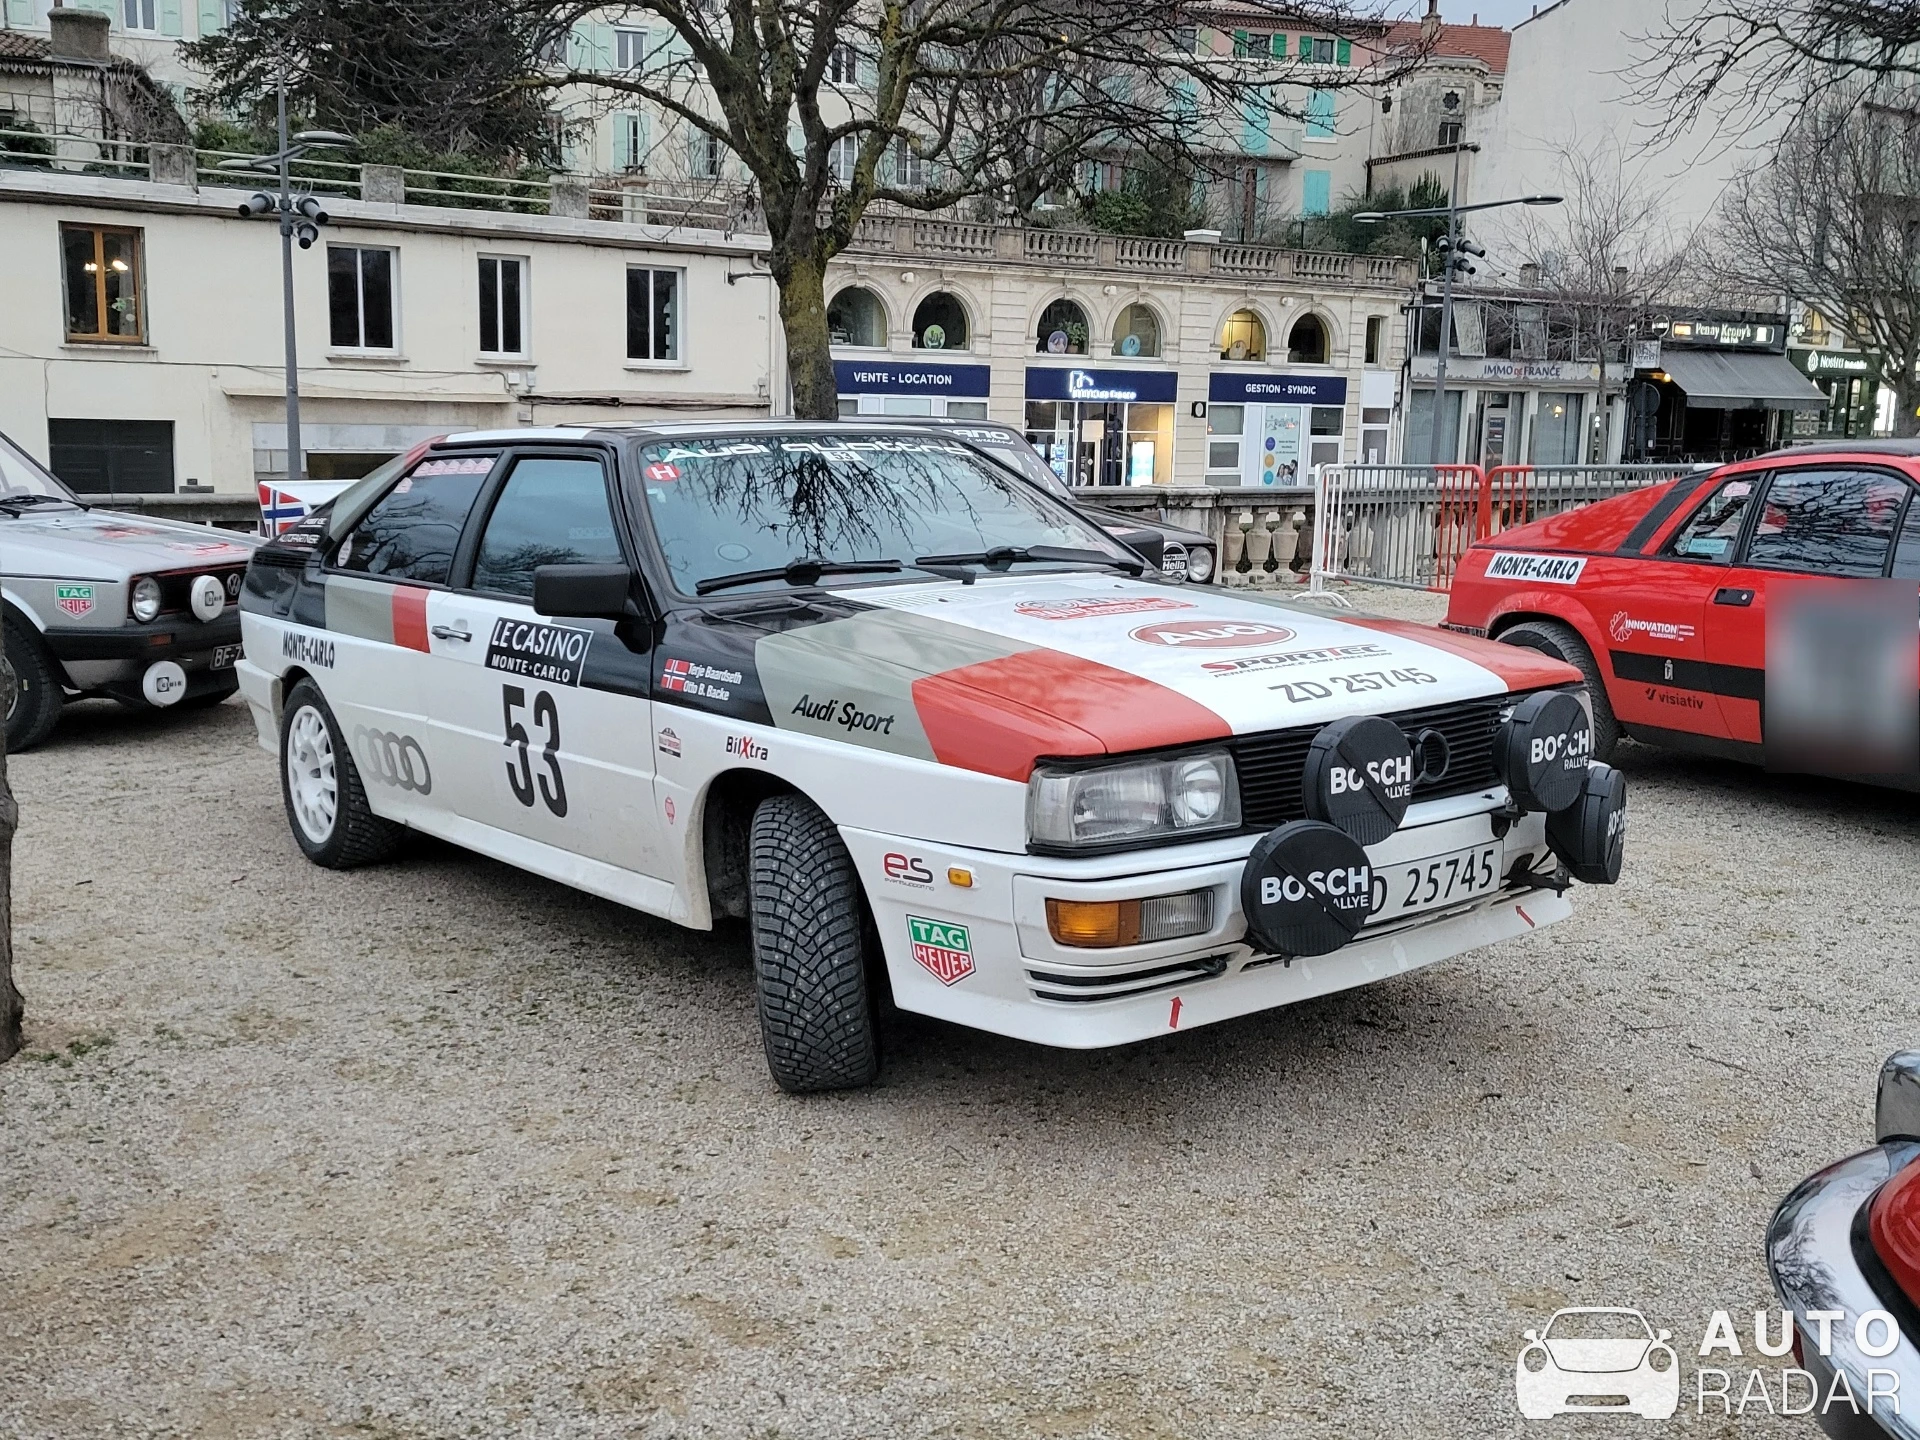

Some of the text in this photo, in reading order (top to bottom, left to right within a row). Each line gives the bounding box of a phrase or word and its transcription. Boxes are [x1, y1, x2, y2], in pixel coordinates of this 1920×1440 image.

[853, 371, 889, 383] VENTE
[898, 373, 952, 385] LOCATION
[1484, 365, 1513, 376] IMMO
[1523, 365, 1562, 378] FRANCE
[1245, 383, 1281, 394] GESTION
[1287, 385, 1317, 395] SYNDIC
[650, 465, 677, 480] H
[1162, 560, 1186, 571] Hella
[1490, 555, 1580, 581] MONTE-CARLO
[59, 587, 90, 597] TAG
[59, 600, 92, 615] HEUER
[1152, 623, 1285, 645] Audi
[1625, 619, 1678, 634] INNOVATION
[282, 630, 335, 669] MONTE-CARLO
[511, 623, 584, 662] CASINO
[688, 662, 706, 679] Terje
[706, 687, 730, 702] Backe
[1267, 667, 1438, 704] ZD 25745
[1659, 692, 1705, 711] visiativ
[791, 694, 896, 735] Audi Sport
[501, 683, 568, 819] 53
[1530, 729, 1590, 764] BOSCH
[1563, 755, 1589, 771] RALLYE
[1329, 755, 1412, 795] BOSCH
[1260, 865, 1370, 905] BOSCH
[1402, 850, 1495, 908] 25745
[913, 922, 965, 949] TAG
[917, 946, 970, 980] HEUER
